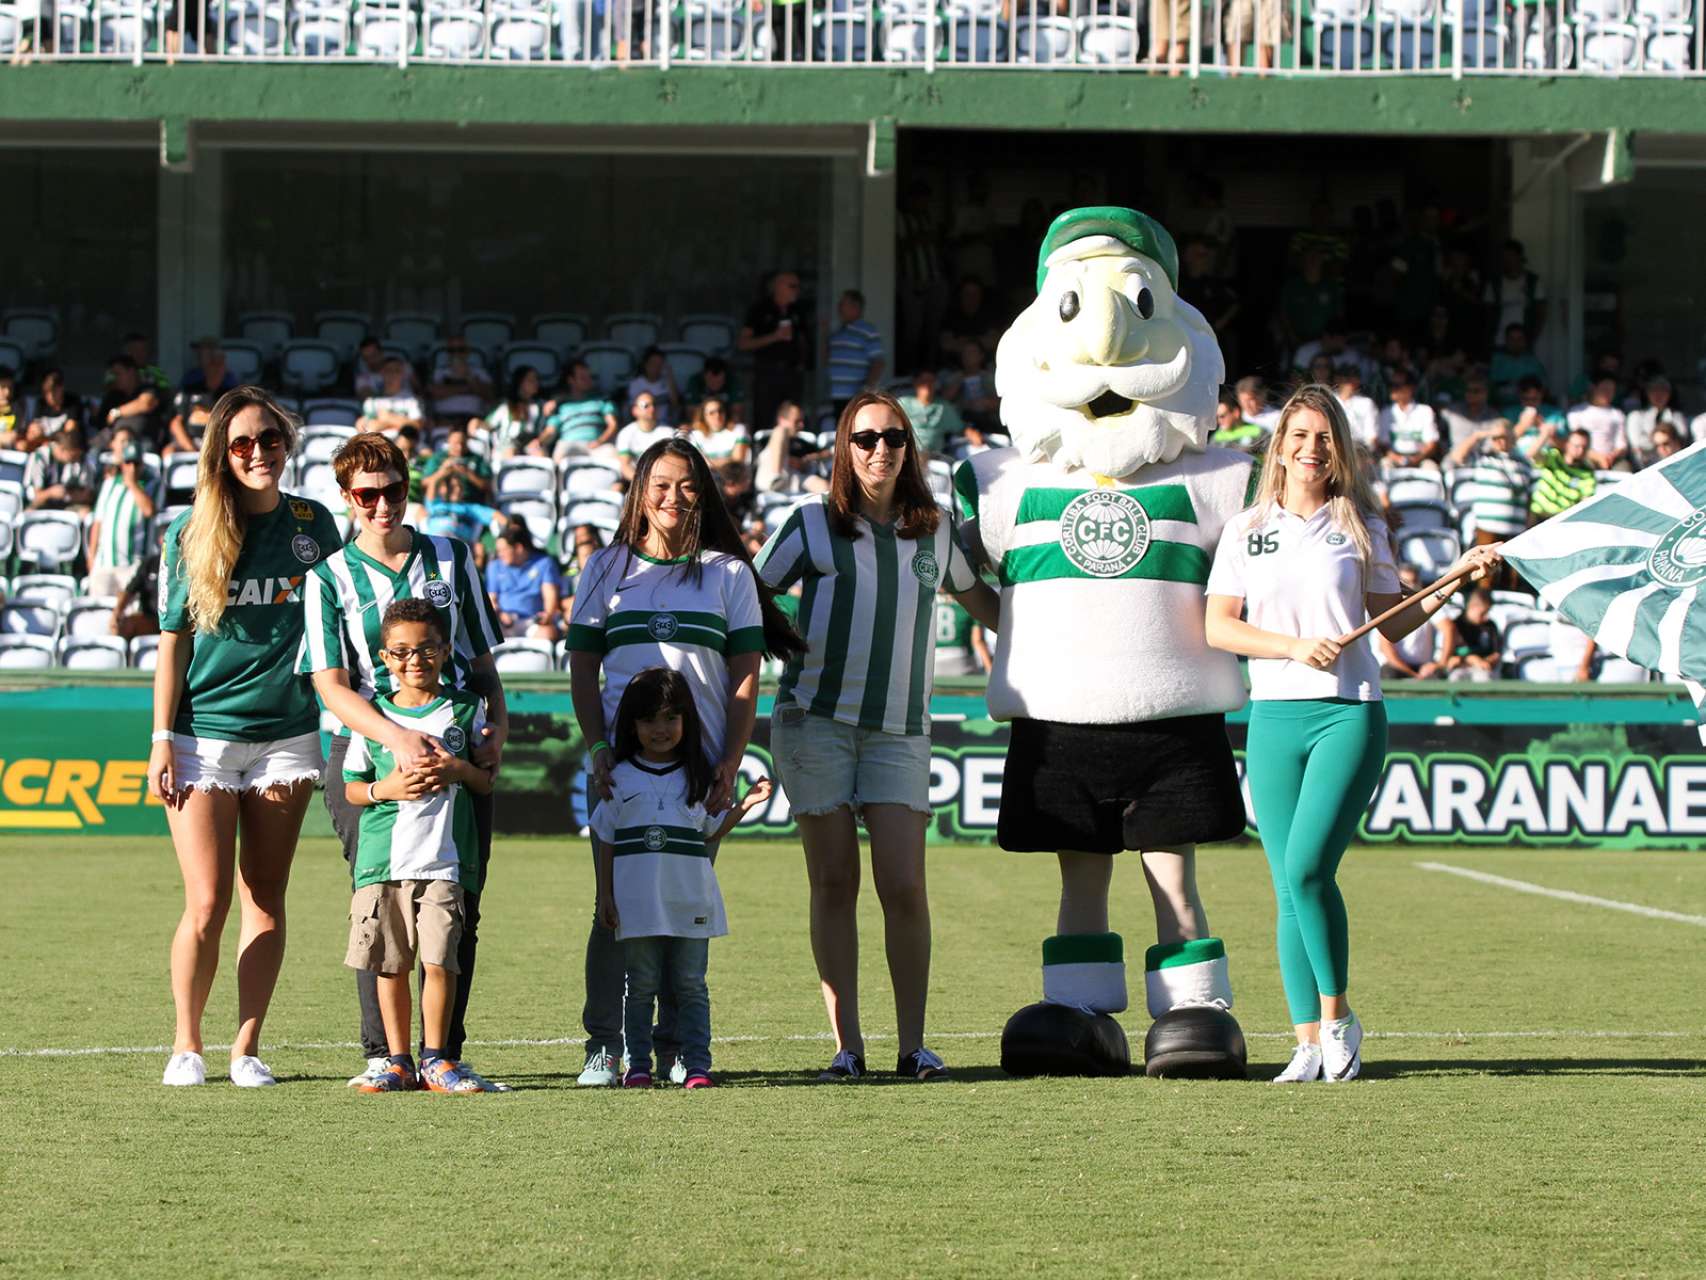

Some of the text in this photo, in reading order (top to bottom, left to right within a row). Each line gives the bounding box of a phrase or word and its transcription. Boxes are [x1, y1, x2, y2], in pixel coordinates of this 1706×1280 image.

[1062, 501, 1085, 554] CORITIBA
[1132, 524, 1146, 554] CLUB
[1078, 520, 1130, 542] CFC
[1247, 529, 1279, 556] 85
[226, 576, 305, 606] CAIX
[0, 758, 166, 824] CRE
[1369, 764, 1706, 832] ARANAE
